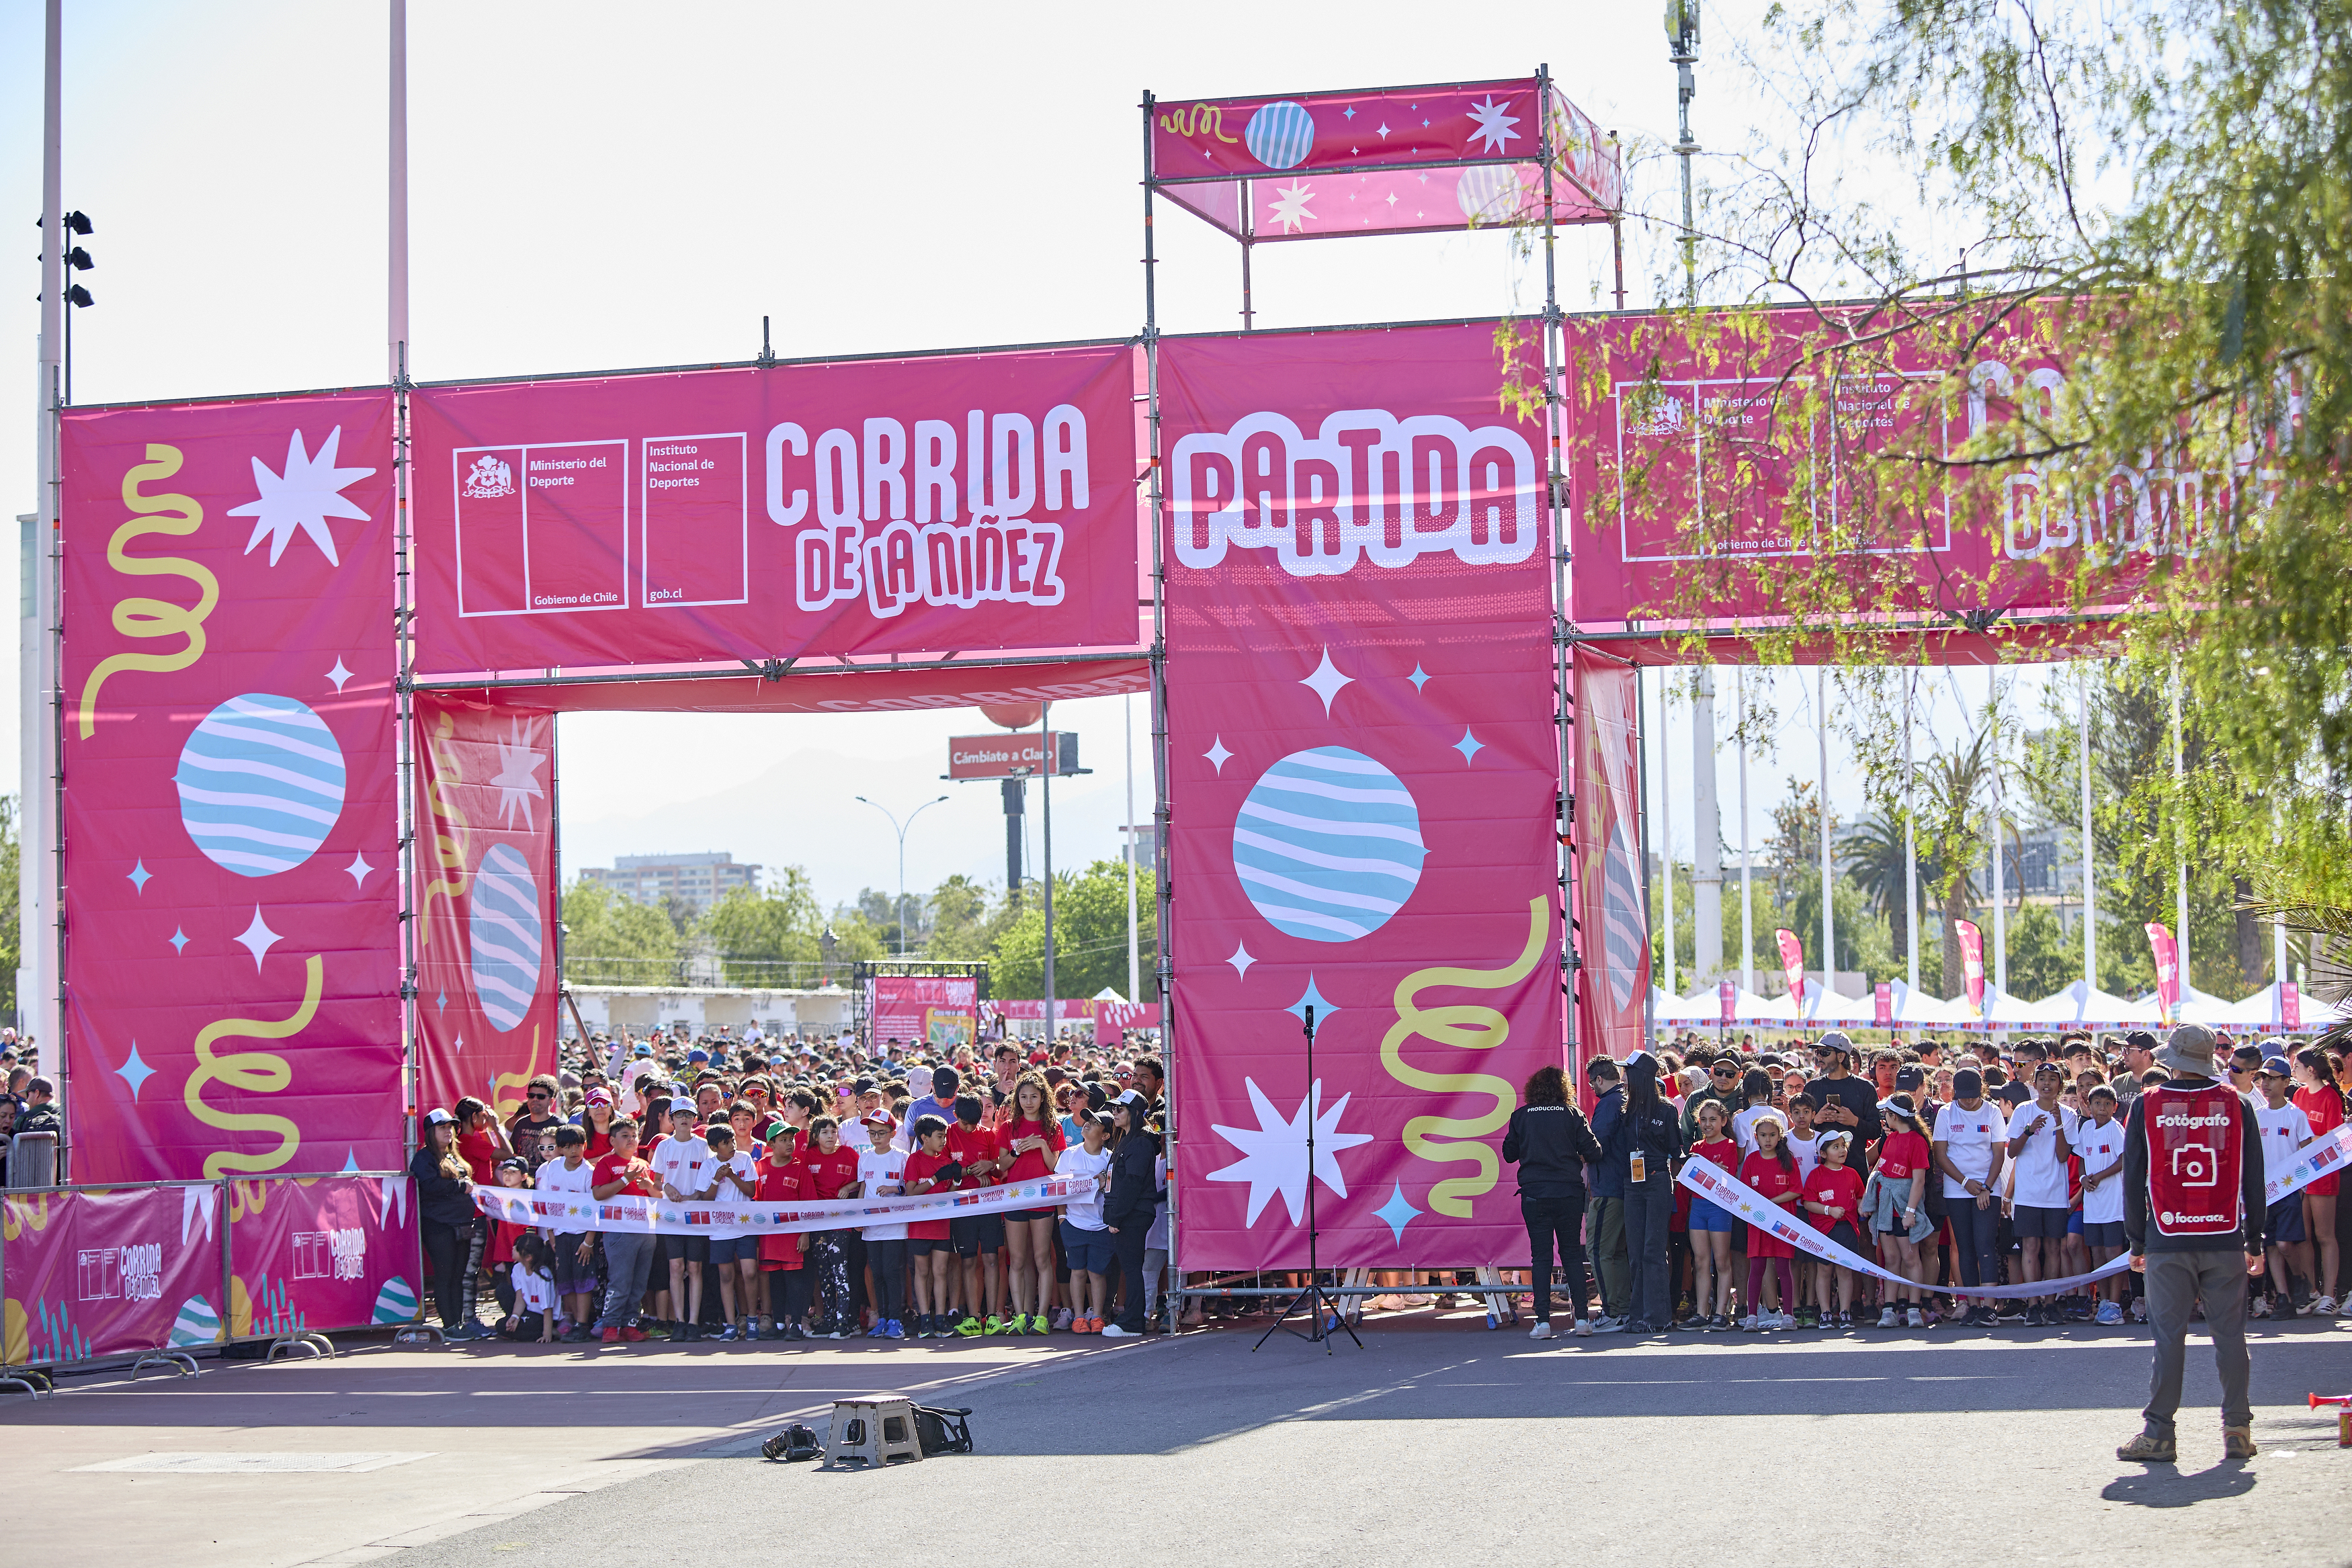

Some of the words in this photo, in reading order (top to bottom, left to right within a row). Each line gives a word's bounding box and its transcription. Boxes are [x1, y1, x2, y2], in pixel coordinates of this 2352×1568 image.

[649, 444, 698, 457] Instituto
[530, 460, 587, 472] Ministerio
[589, 456, 607, 469] del
[649, 459, 699, 473] Nacional
[700, 458, 715, 470] de
[765, 404, 1090, 527] CORRIDA
[530, 475, 575, 489] Deporte
[649, 476, 700, 490] Deportes
[1180, 415, 1529, 568] PARTIDA
[1761, 537, 1775, 549] de
[534, 593, 578, 606] Gobierno
[579, 593, 592, 603] de
[593, 592, 618, 603] Chile
[649, 589, 683, 602] gob.cl
[953, 750, 1009, 765] Cámbiate
[1011, 752, 1019, 762] a
[1527, 1105, 1564, 1113] PRODUCCIÓN
[2155, 1113, 2230, 1129] Fotógrafo
[1068, 1178, 1093, 1188] CORRIDA
[1716, 1183, 1739, 1202] CORRIDA
[624, 1207, 647, 1217] CORRIDA
[712, 1211, 735, 1219] CORRIDA
[2175, 1211, 2230, 1223] focorace_
[331, 1227, 366, 1257] CORRIDA
[1800, 1236, 1824, 1252] CORRIDA
[121, 1242, 162, 1276] CORRIDA
